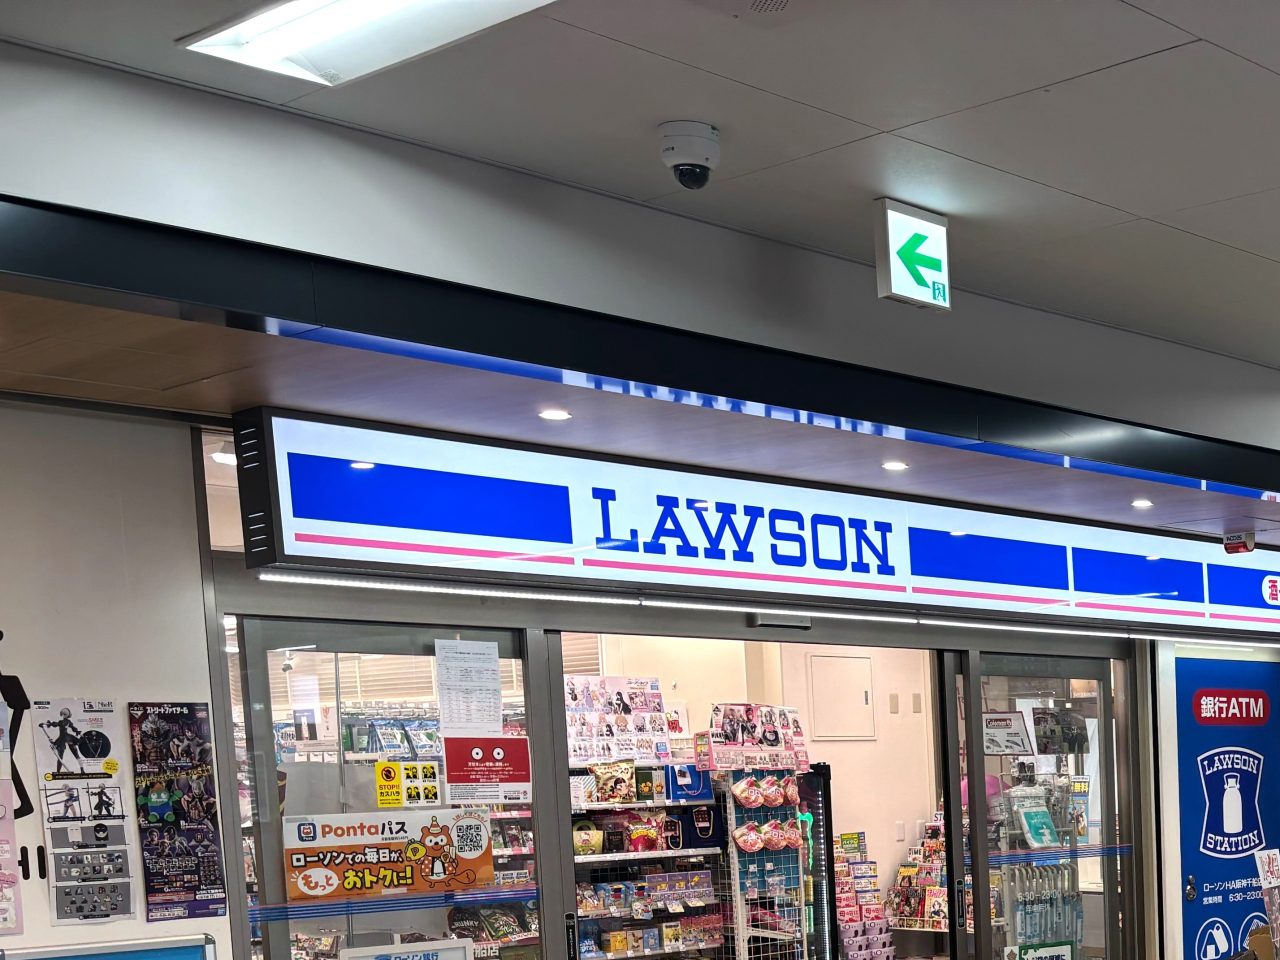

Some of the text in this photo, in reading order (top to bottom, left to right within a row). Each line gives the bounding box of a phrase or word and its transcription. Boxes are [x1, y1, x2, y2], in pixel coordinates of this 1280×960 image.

[591, 486, 897, 577] LAWSON
[1200, 695, 1264, 718] 銀行ATM
[1203, 754, 1259, 775] LAWSON
[321, 820, 409, 839] Pontaパス
[1206, 829, 1260, 851] STATION
[301, 872, 335, 892] もっと
